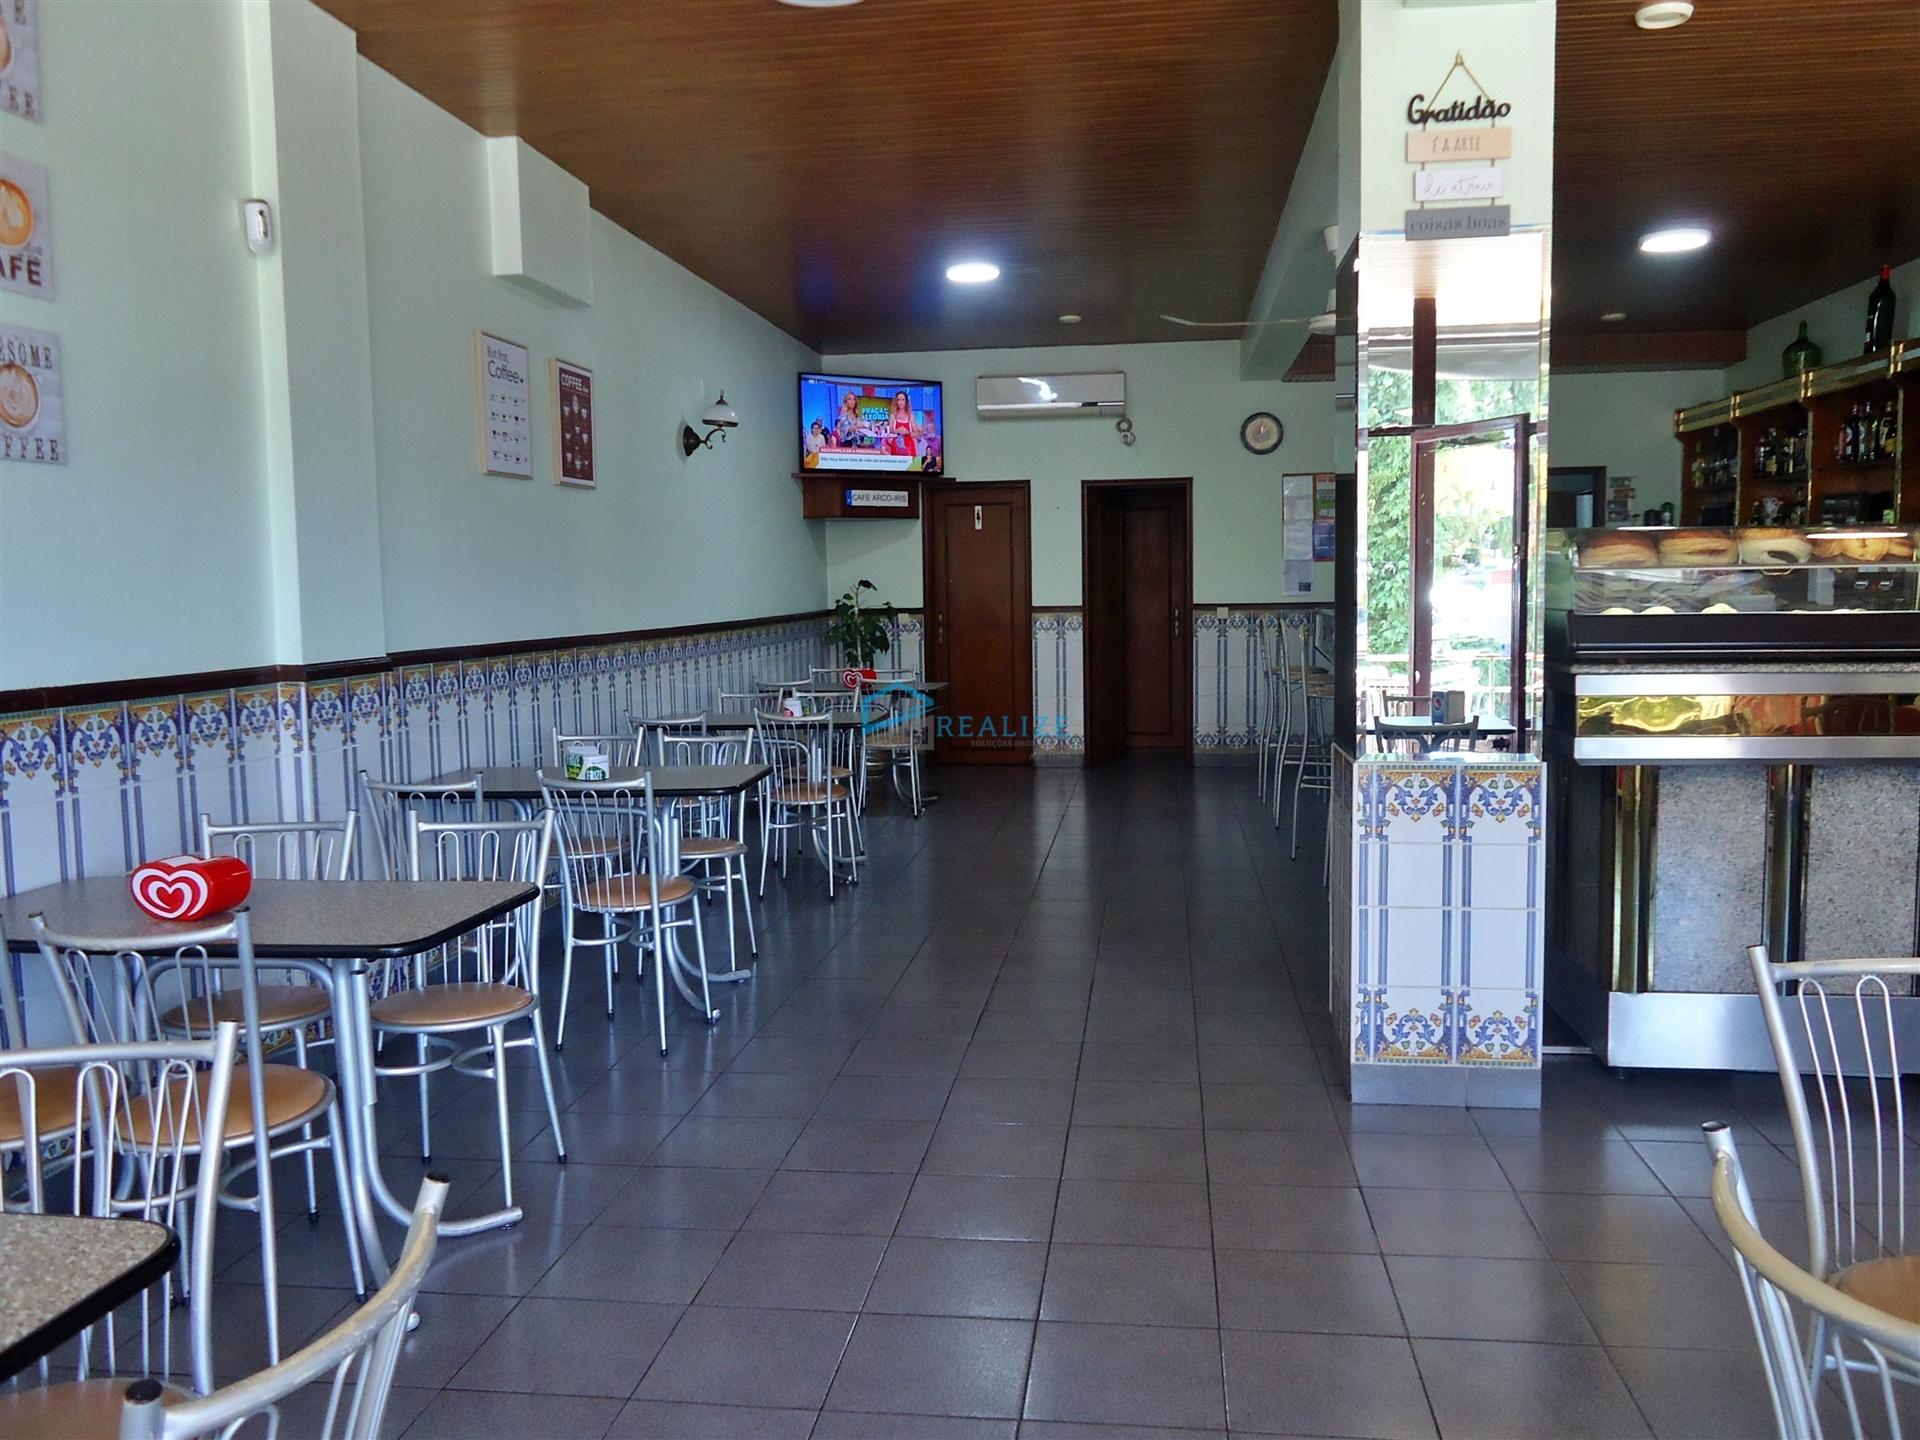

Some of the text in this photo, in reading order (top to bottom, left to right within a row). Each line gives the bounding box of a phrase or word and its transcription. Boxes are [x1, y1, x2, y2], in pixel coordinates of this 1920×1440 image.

[1407, 94, 1511, 124] Gratidão
[1442, 138, 1449, 152] A
[1454, 136, 1480, 152] ARTE
[1410, 213, 1506, 233] coisas boas
[561, 373, 582, 391] COFFEE
